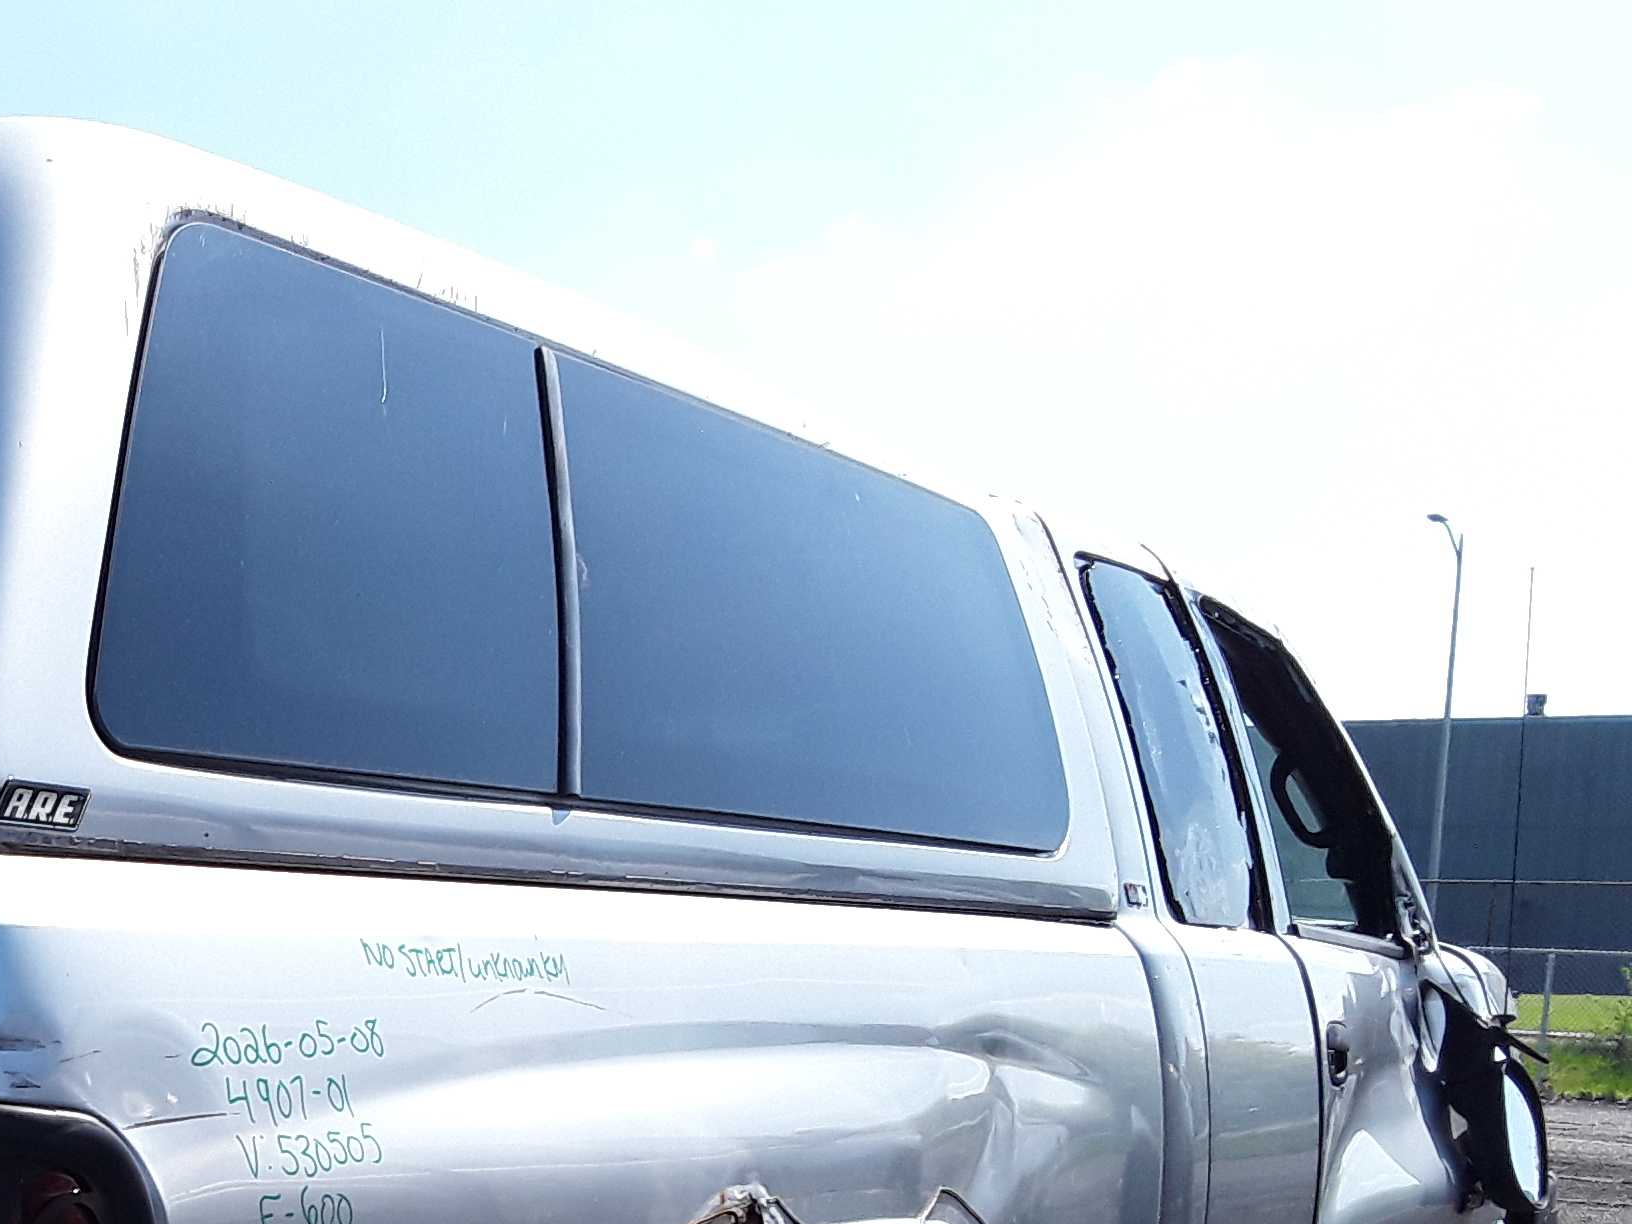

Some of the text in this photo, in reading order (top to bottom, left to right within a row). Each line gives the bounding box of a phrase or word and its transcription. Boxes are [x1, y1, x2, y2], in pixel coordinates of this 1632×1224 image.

[360, 937, 395, 969] NO
[191, 1018, 385, 1067] 2026-05-08
[226, 1074, 355, 1126] 4907-01
